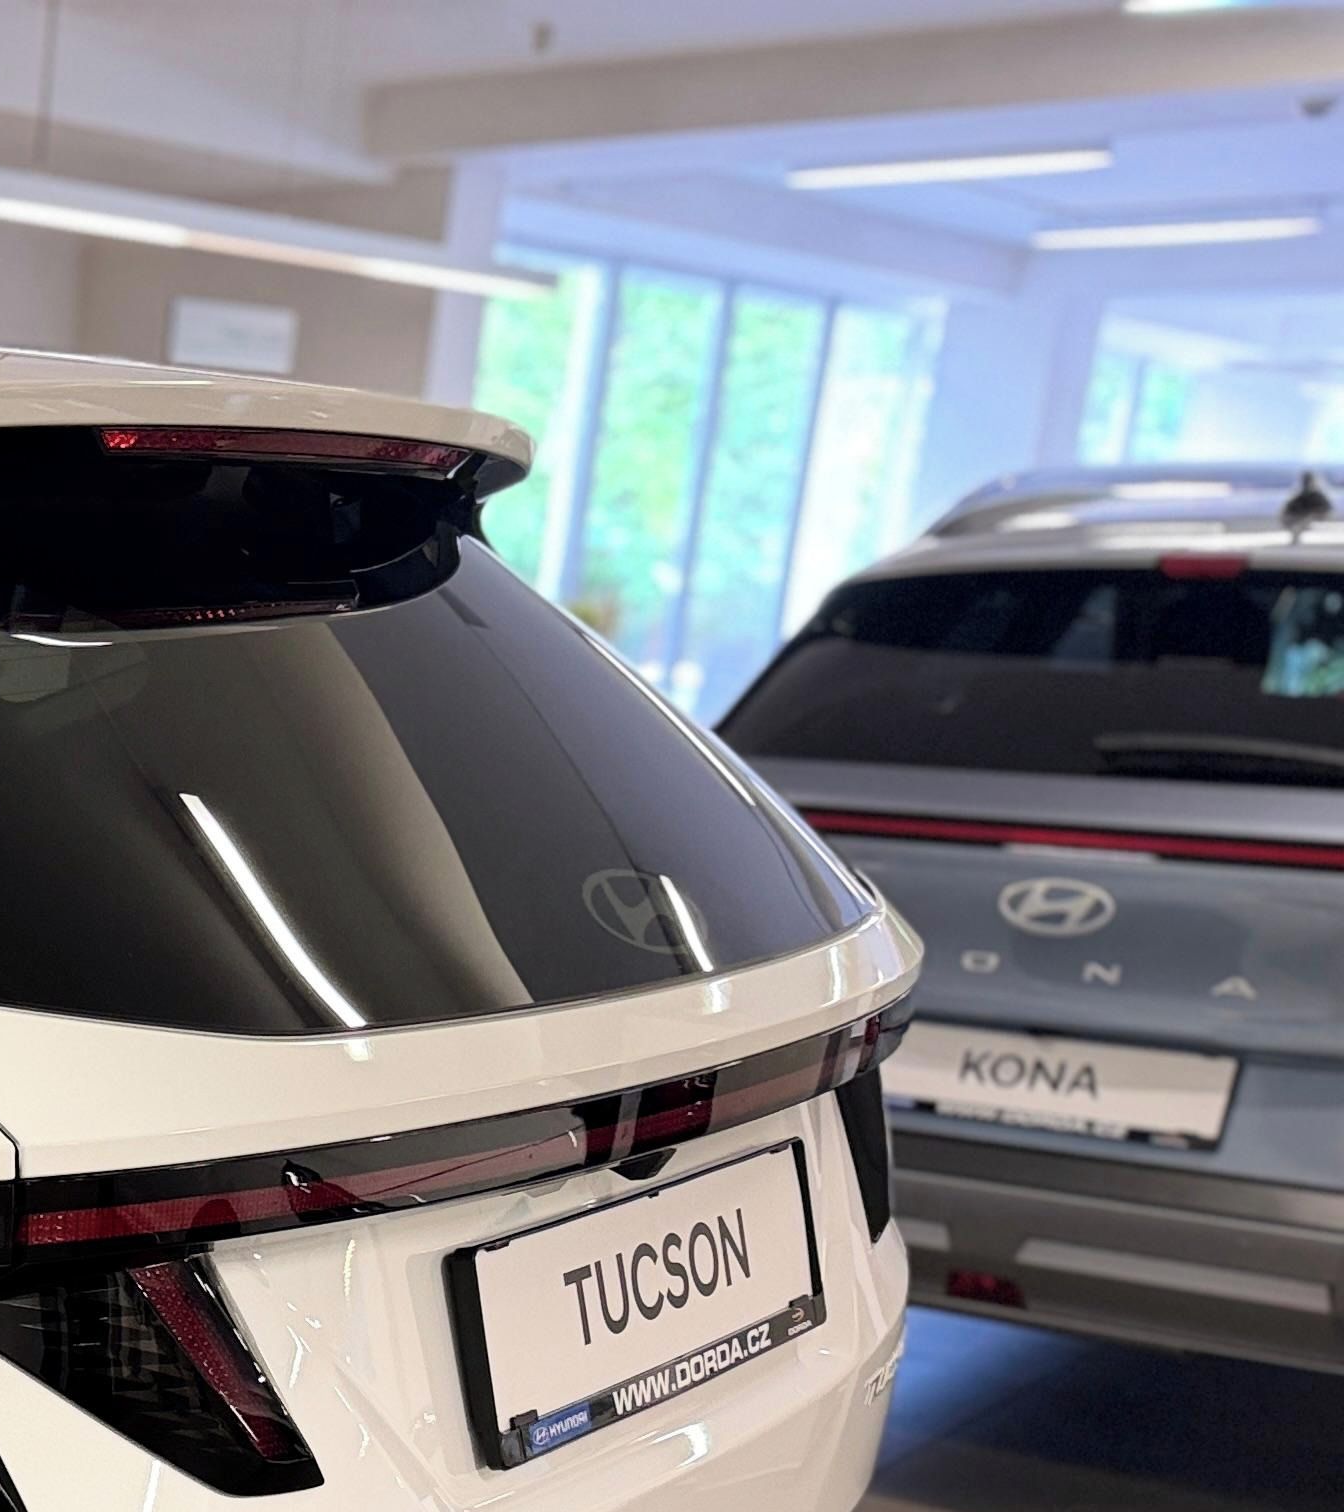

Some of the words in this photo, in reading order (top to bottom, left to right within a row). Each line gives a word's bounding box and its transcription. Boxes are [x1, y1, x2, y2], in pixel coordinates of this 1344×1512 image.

[960, 1047, 1099, 1099] KONA
[563, 1208, 751, 1345] TUCSON
[613, 1322, 772, 1415] WWW.DORDA.CZ
[548, 1410, 588, 1438] HYUNDAI
